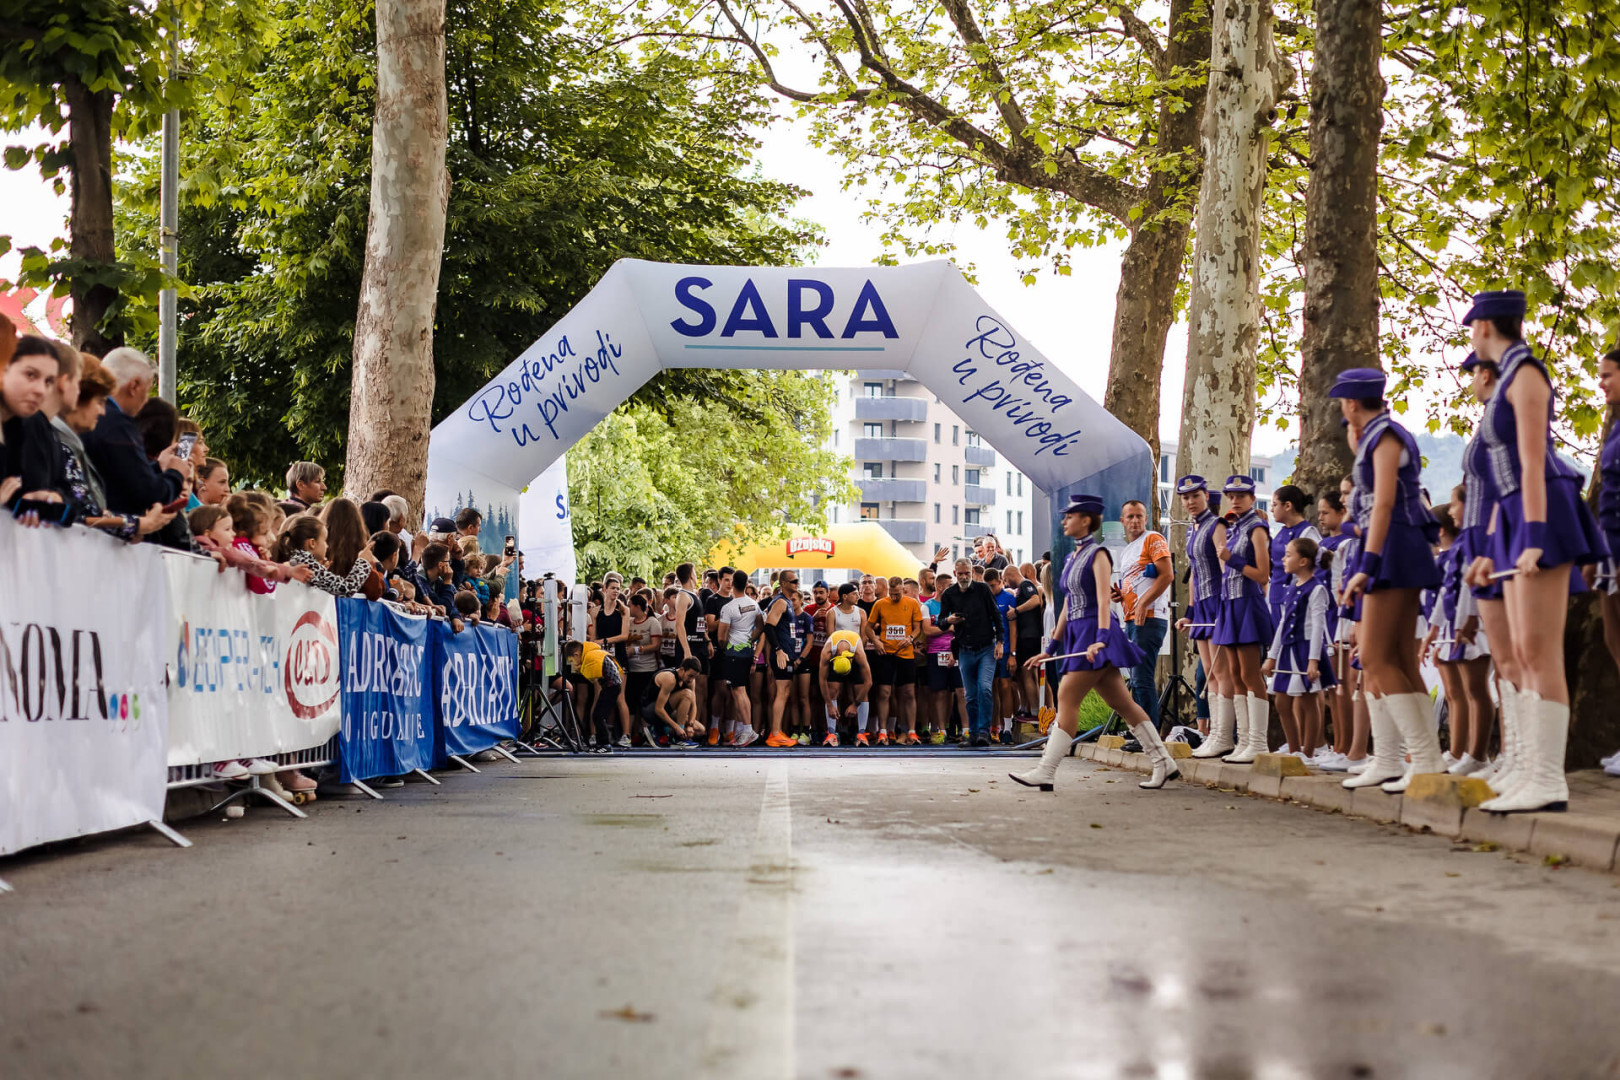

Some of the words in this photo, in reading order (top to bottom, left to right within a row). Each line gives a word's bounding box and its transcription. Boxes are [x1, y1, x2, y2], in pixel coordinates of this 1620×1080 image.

[670, 276, 900, 339] SARA
[468, 335, 576, 433] Rođena
[952, 358, 978, 385] u
[965, 315, 1073, 414] Rođena
[511, 423, 540, 447] u
